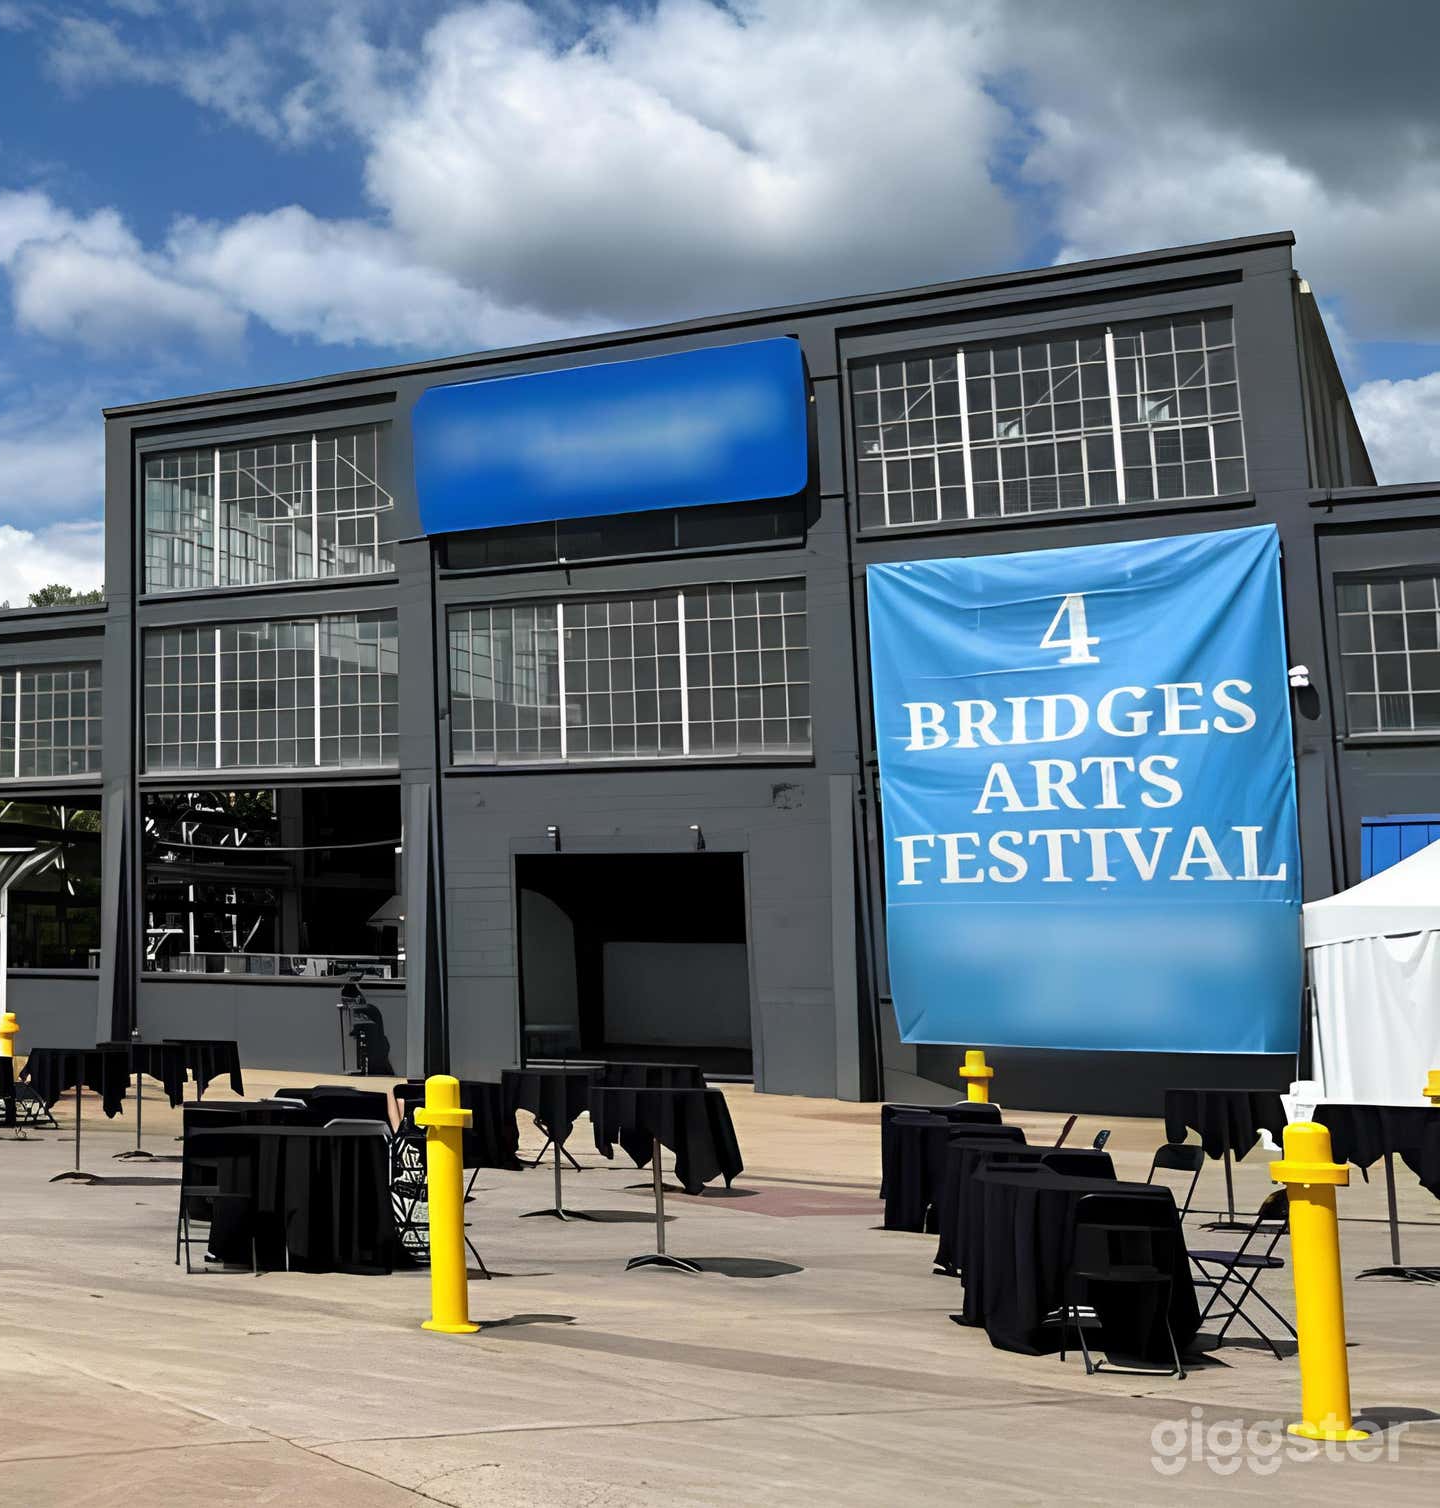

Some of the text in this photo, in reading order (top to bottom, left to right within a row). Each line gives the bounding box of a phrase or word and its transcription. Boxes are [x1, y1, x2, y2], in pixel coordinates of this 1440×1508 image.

[1039, 592, 1101, 665] 4
[901, 678, 1258, 752] BRIDGES
[971, 755, 1184, 815] ARTS
[893, 825, 1288, 886] FESTIVAL
